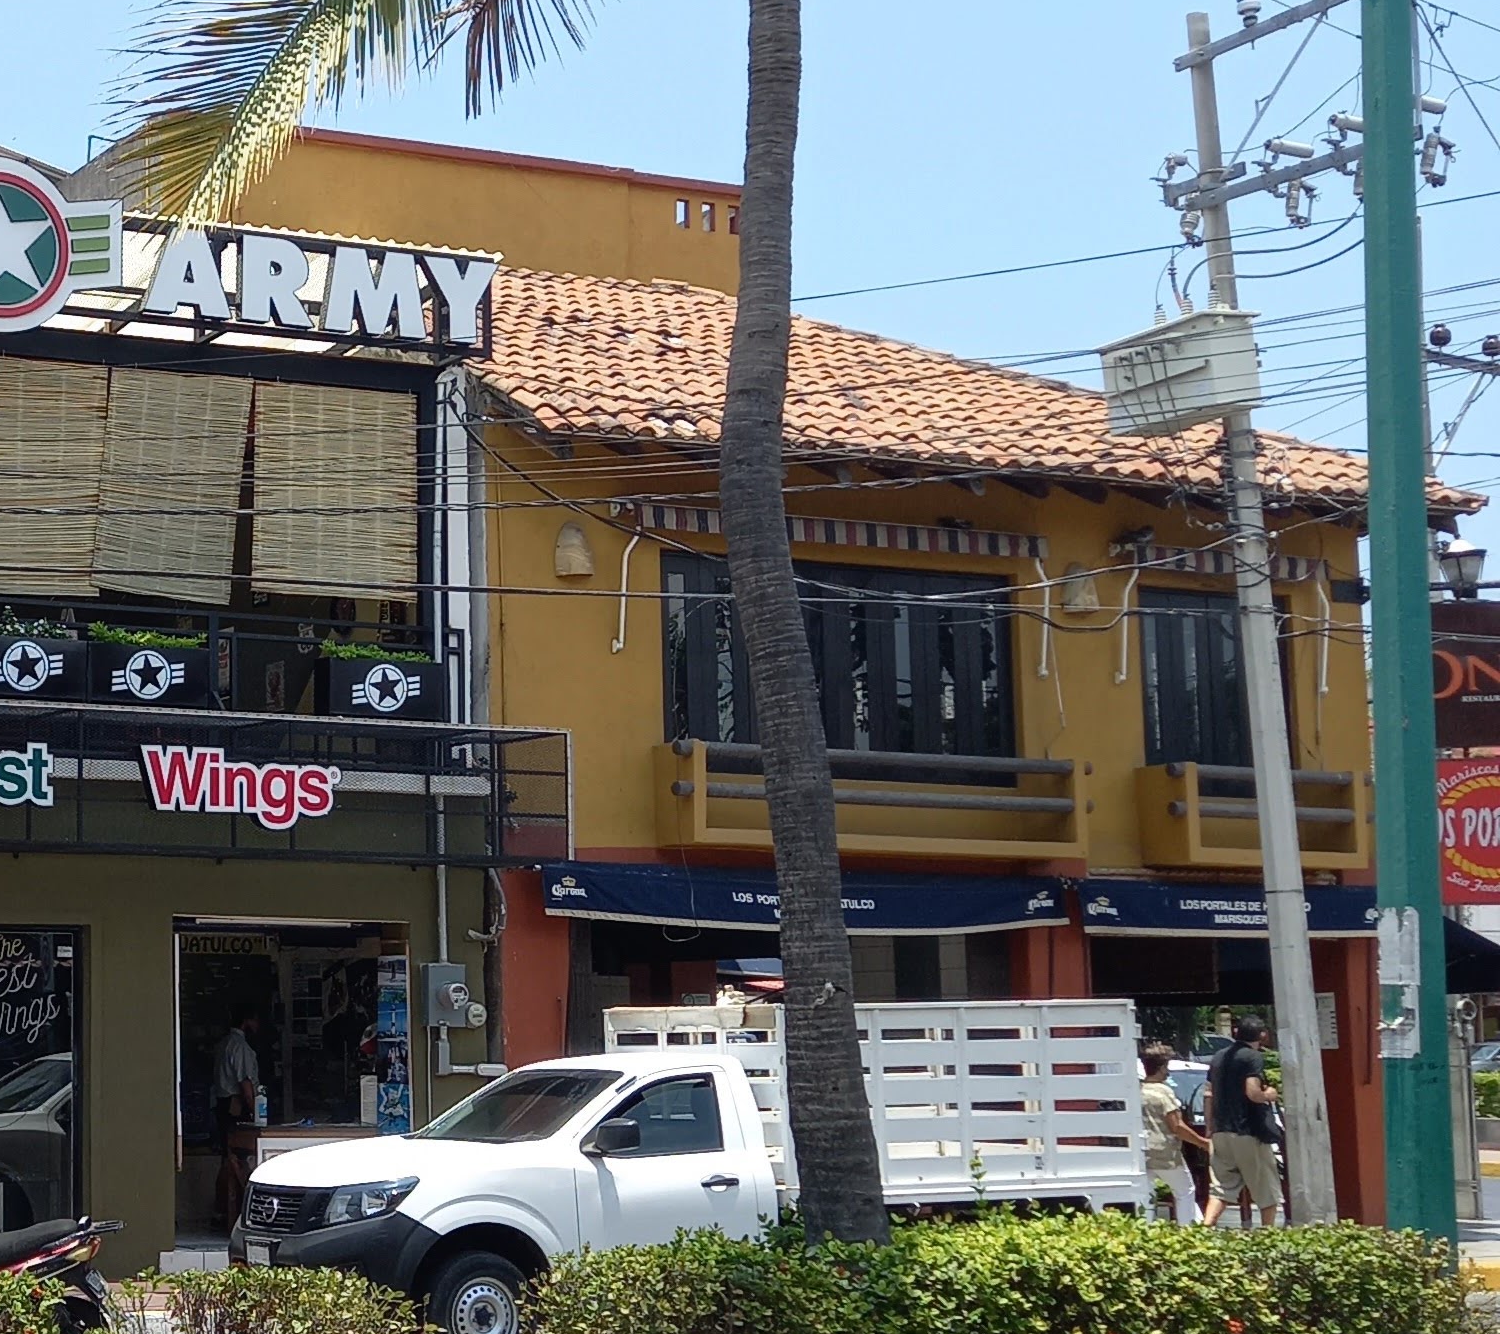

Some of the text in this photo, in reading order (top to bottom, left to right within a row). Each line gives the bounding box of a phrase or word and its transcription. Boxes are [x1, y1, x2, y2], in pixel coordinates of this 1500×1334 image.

[145, 227, 500, 345] ARMY
[731, 891, 754, 904] LOS
[1179, 899, 1200, 910] LOS
[1200, 899, 1247, 911] PORTALES
[1247, 901, 1261, 912] DE
